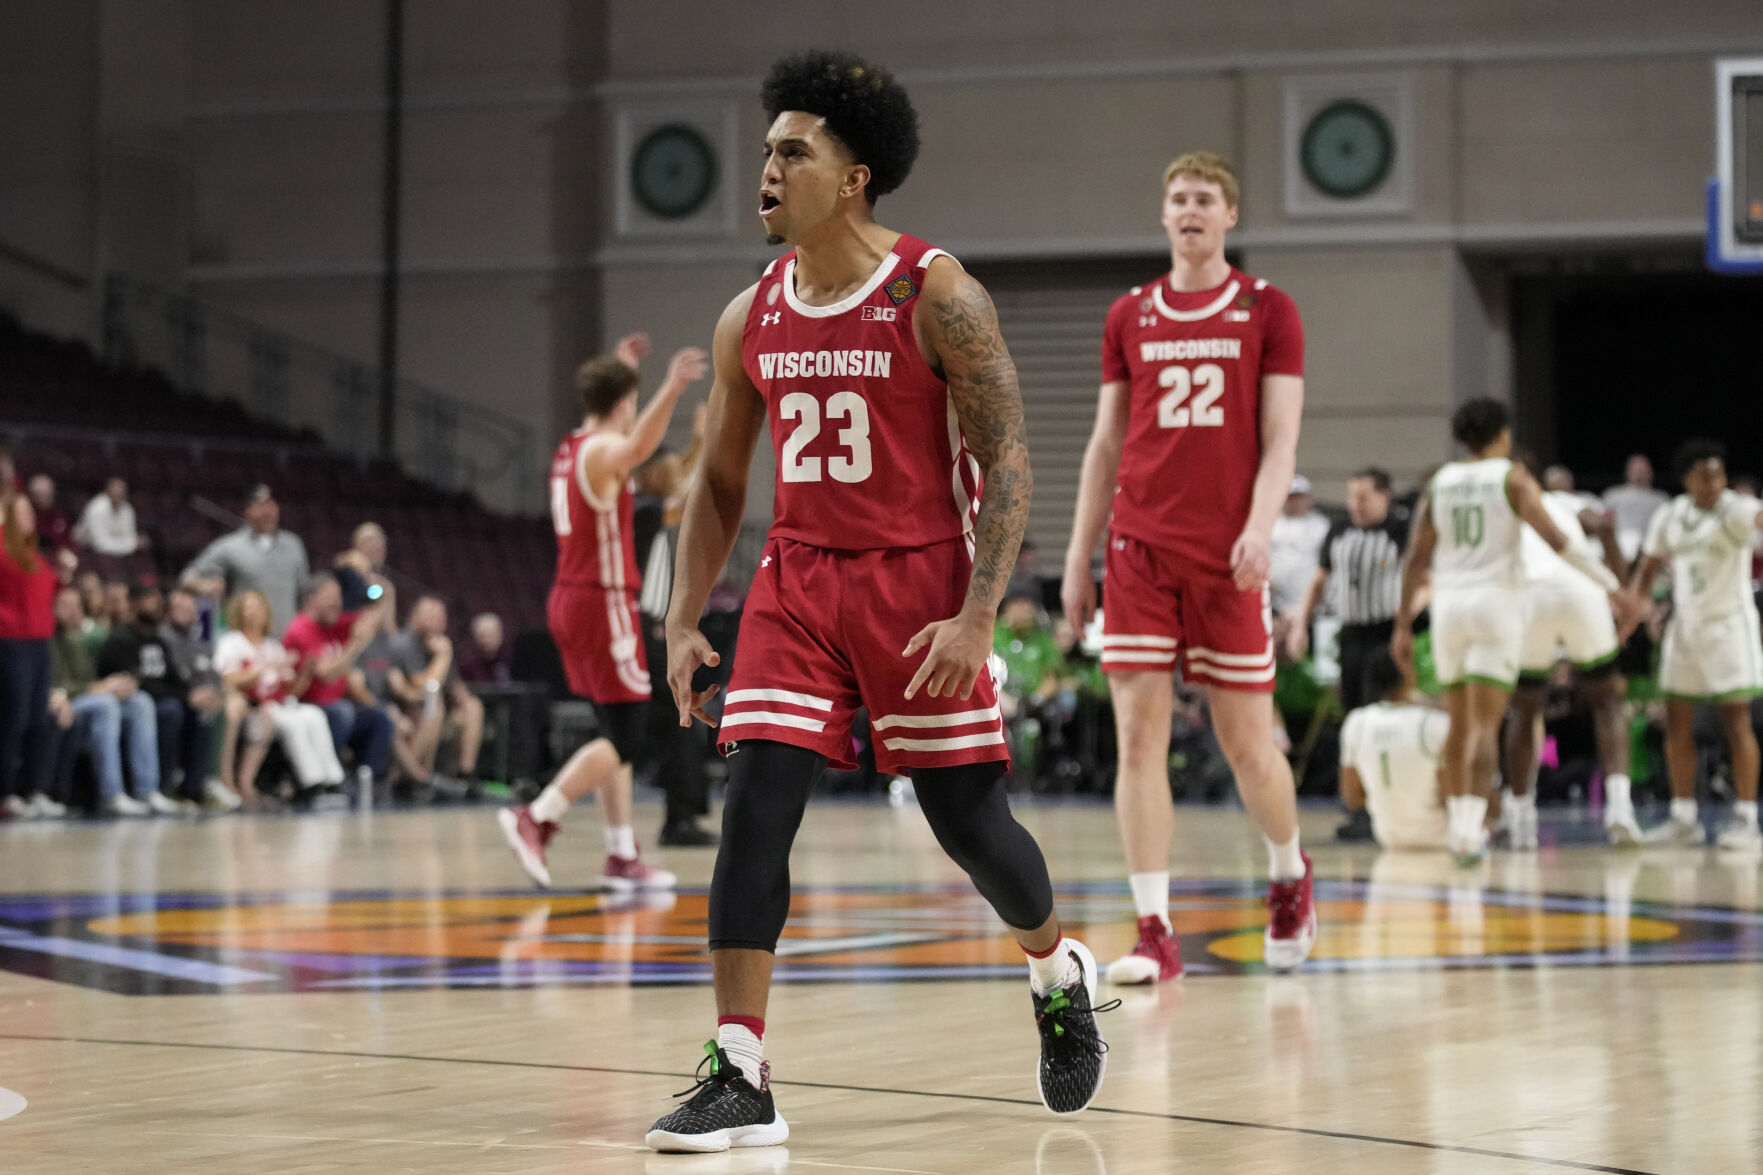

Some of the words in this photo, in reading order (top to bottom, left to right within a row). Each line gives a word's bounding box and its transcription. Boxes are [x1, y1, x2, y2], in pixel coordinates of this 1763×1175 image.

[758, 350, 892, 379] WISCONSIN
[1140, 338, 1242, 362] WISCONSIN
[1158, 363, 1225, 428] 22
[780, 391, 873, 483] 23
[1452, 504, 1485, 546] 10
[1379, 751, 1392, 787] 1
